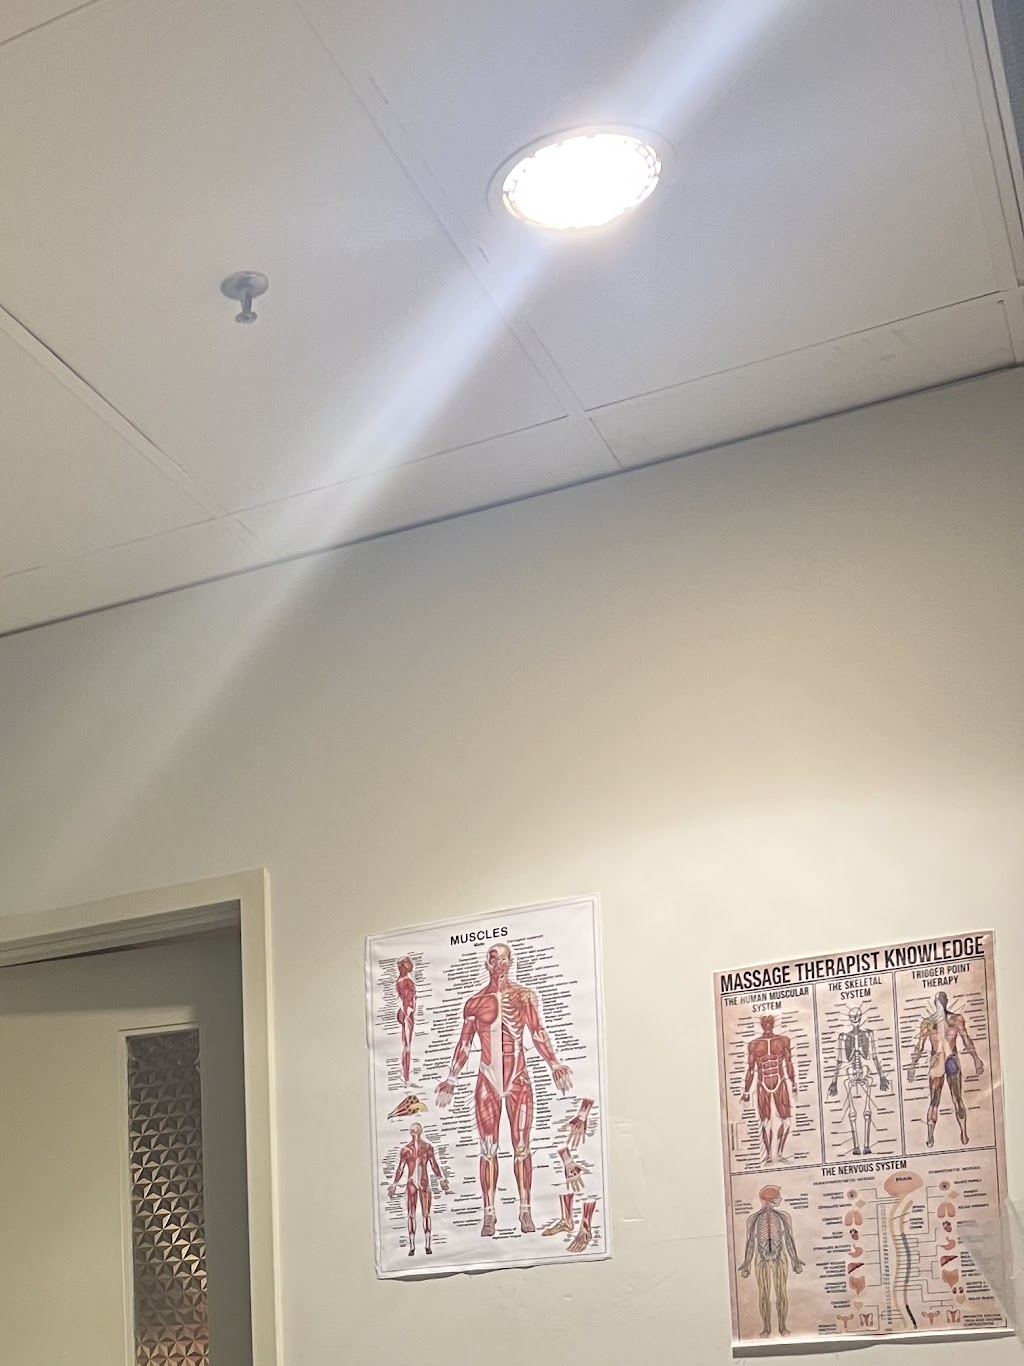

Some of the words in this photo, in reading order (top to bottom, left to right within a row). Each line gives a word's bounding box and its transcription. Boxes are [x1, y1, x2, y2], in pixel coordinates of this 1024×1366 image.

[450, 926, 508, 946] MUSCLES
[720, 966, 792, 993] MASSAGE
[795, 951, 881, 982] THERAPIST
[884, 936, 985, 969] KNOWLEDGE
[911, 966, 945, 980] TRIGGER
[947, 962, 971, 975] POINT
[828, 981, 842, 992] THE
[845, 976, 883, 990] SKELETAL
[922, 975, 959, 989] THERAPY
[724, 996, 738, 1006] THE
[740, 993, 768, 1004] HUMAN
[769, 986, 810, 1000] MUSCULAR
[840, 988, 871, 1001] SYSTEM
[752, 1001, 782, 1013] SYSTEM
[822, 1167, 836, 1177] THE
[838, 1163, 874, 1175] NERVOUS
[876, 1160, 907, 1172] SYSTEM
